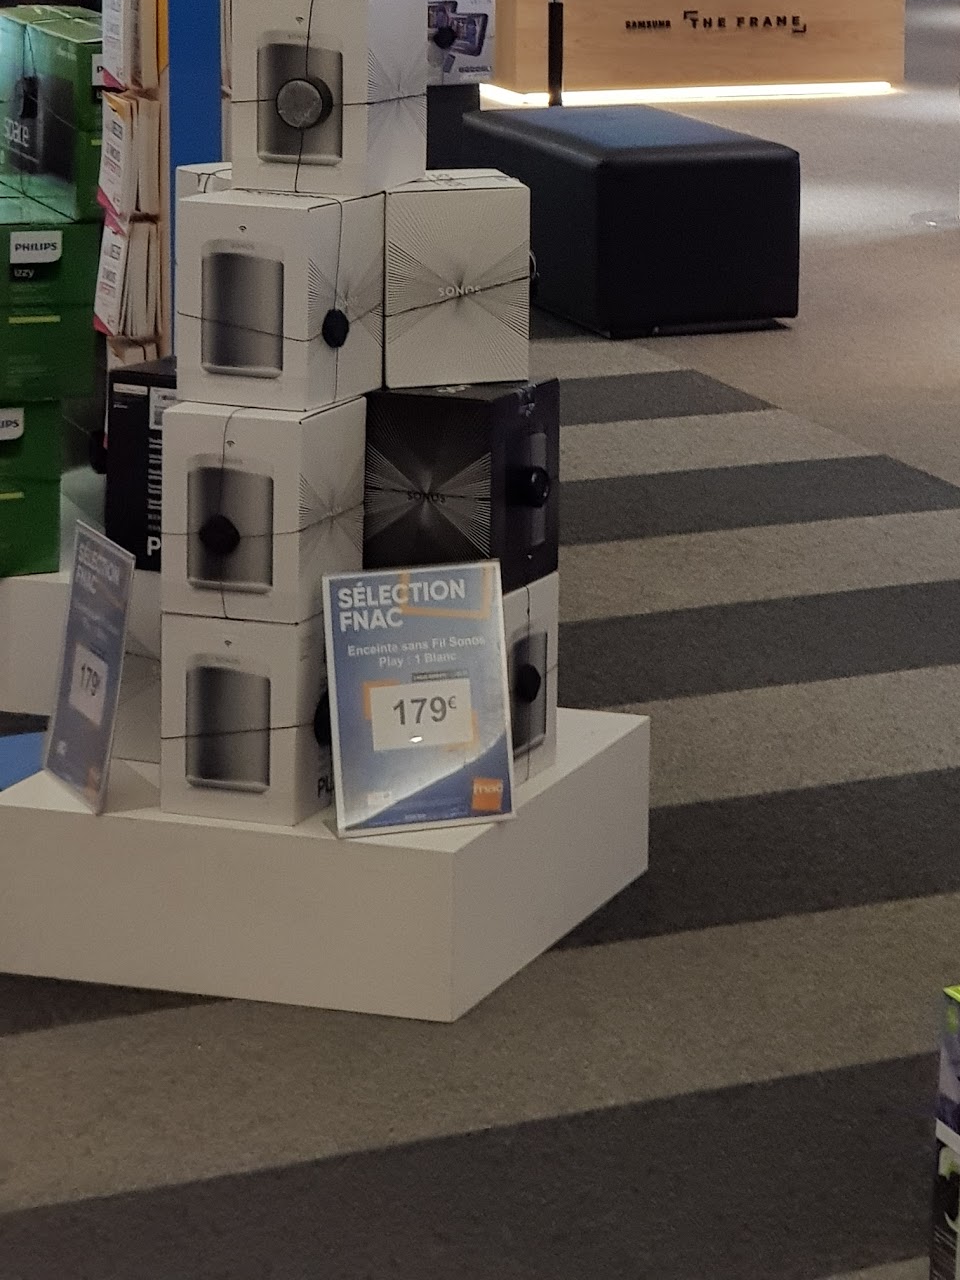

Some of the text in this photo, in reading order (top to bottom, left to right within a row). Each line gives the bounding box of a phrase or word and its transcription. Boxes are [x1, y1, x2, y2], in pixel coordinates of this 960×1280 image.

[625, 19, 671, 30] SAMSUNG
[691, 15, 802, 30] THE FRAME
[14, 241, 58, 252] PHILIPS
[437, 284, 482, 298] SONOS
[406, 490, 446, 504] SONOS
[338, 578, 467, 609] SÉLECTION
[339, 606, 404, 632] FNAC
[347, 642, 399, 658] Enceinte
[401, 640, 429, 653] sans
[449, 635, 486, 648] Sonos
[378, 656, 404, 669] Play
[424, 650, 457, 664] Blanc
[392, 695, 457, 726] 179€
